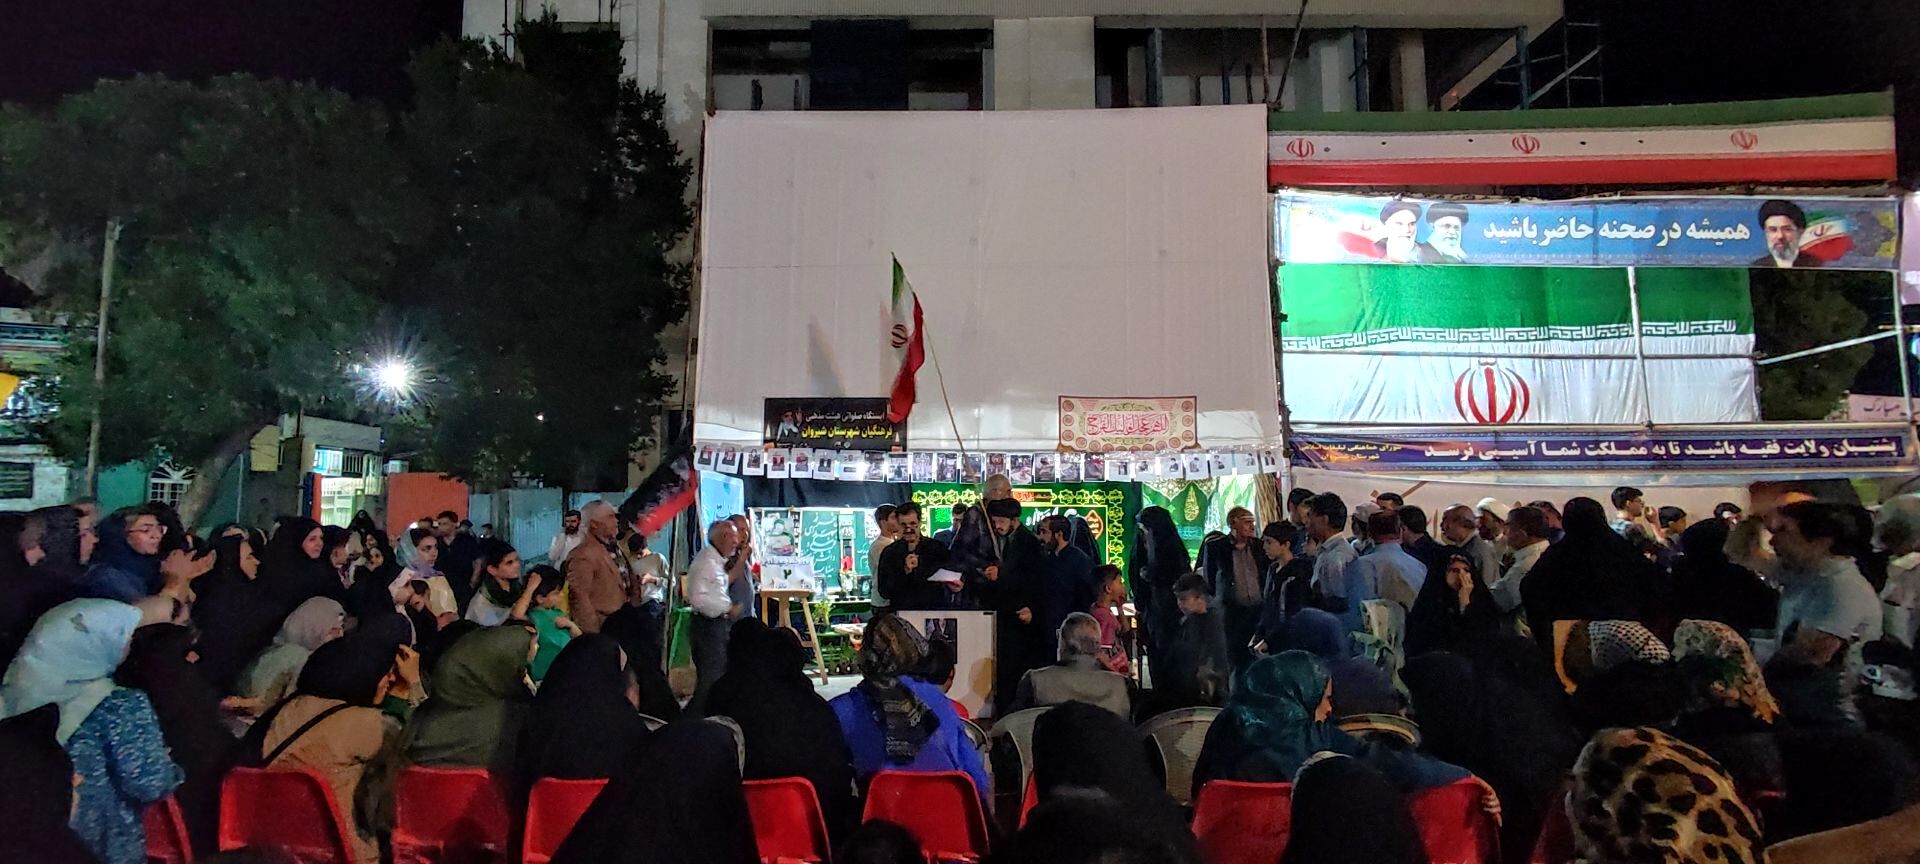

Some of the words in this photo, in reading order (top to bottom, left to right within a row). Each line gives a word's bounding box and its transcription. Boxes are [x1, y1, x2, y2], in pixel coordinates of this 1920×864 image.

[1483, 215, 1539, 246] باشید
[1538, 216, 1594, 247] حاضر
[1598, 219, 1657, 240] صحنه
[1656, 221, 1682, 247] در
[1685, 218, 1751, 246] همیشه
[801, 425, 827, 439] شیروان
[827, 425, 860, 439] شهرستان
[861, 423, 893, 439] فرهنگیان
[1424, 442, 1475, 461] نرسد
[1478, 440, 1536, 461] آسیبی
[1542, 442, 1581, 457] شما
[1585, 440, 1648, 457] مملکت
[1651, 443, 1669, 460] به
[1669, 440, 1681, 455] تا
[1684, 440, 1736, 459] باشید
[1739, 439, 1781, 458] فقیه
[1783, 439, 1830, 457] ولایت
[1832, 437, 1898, 457] پشتیبان
